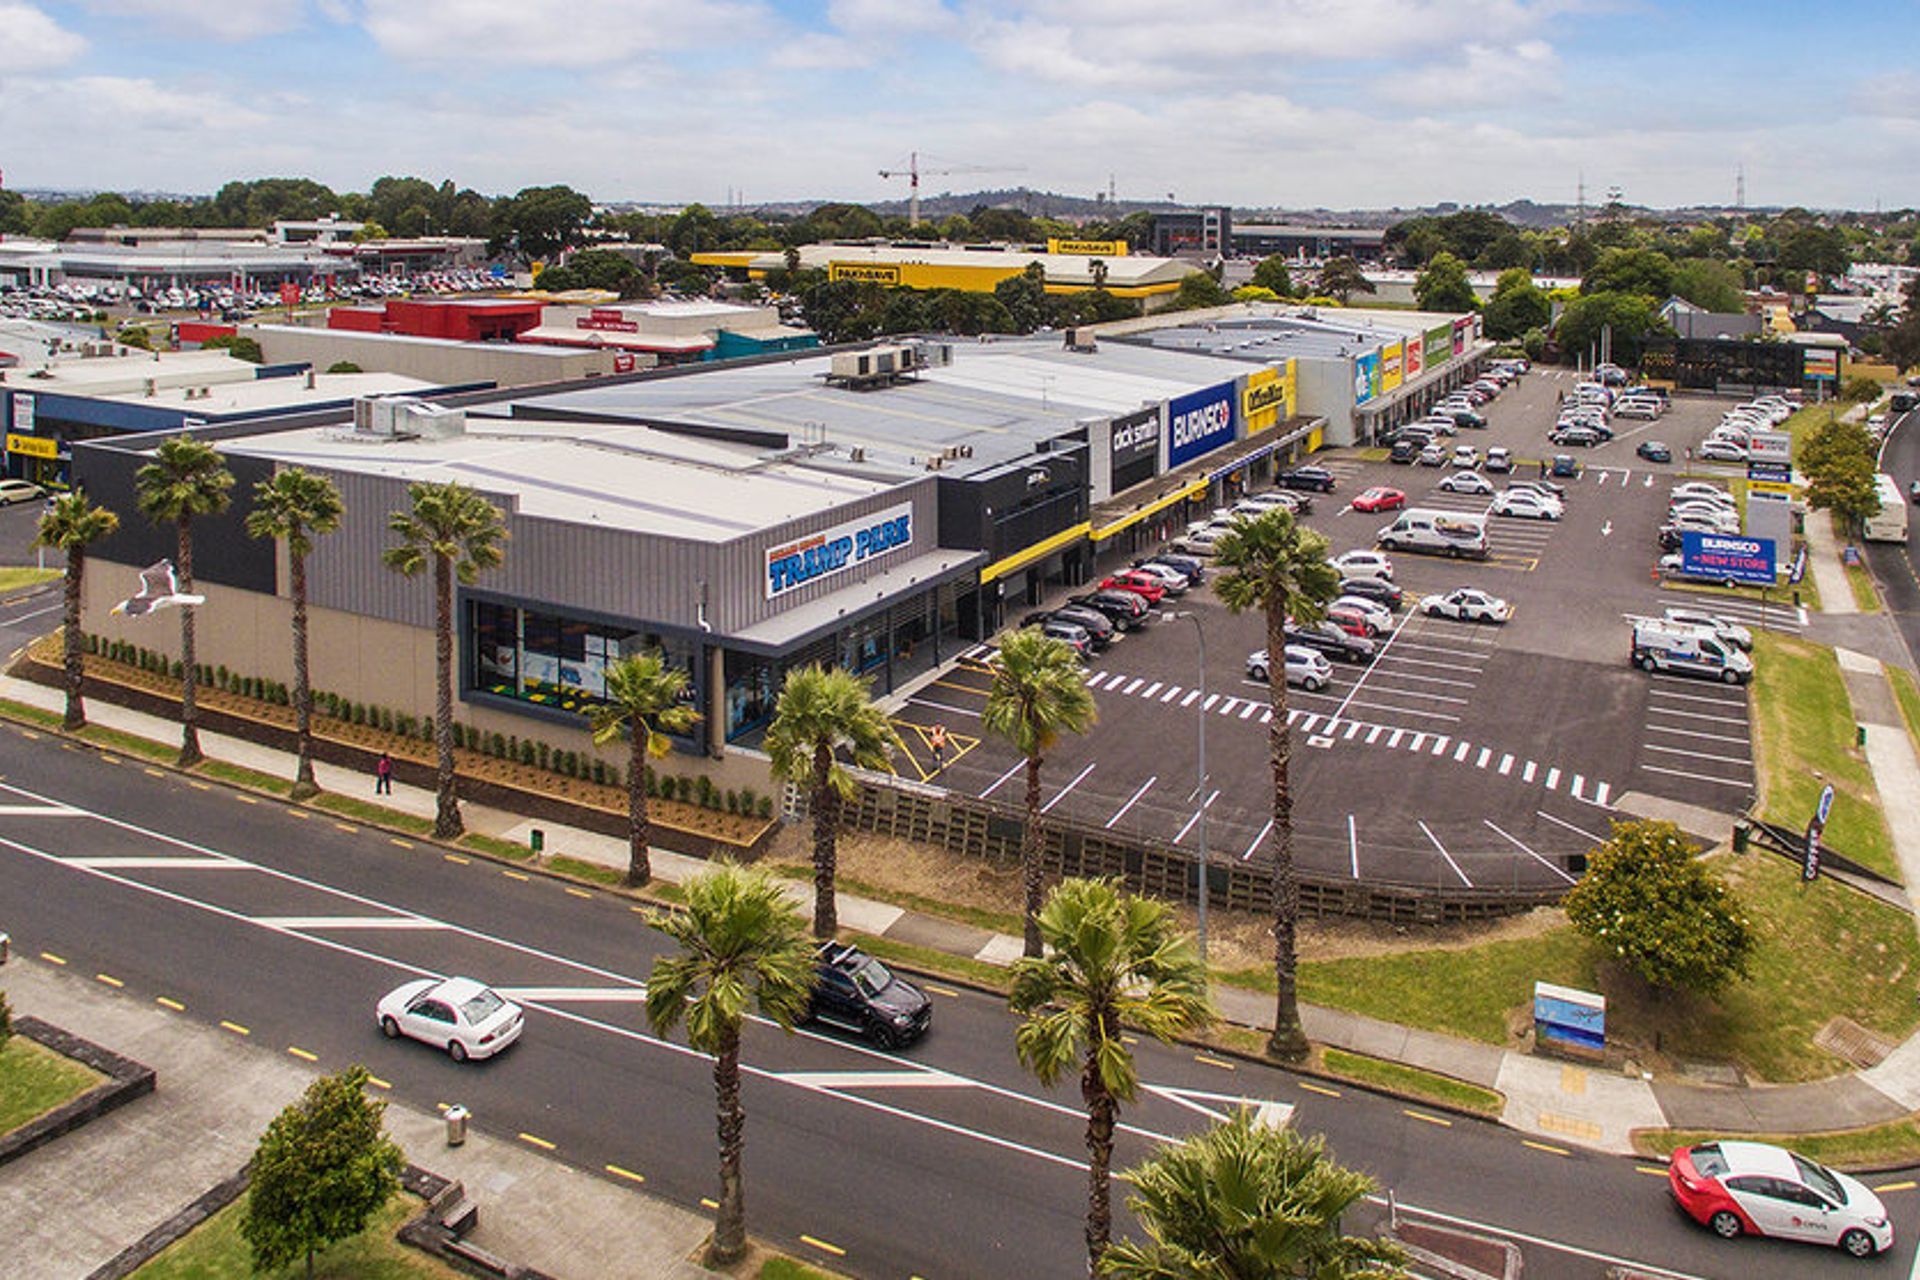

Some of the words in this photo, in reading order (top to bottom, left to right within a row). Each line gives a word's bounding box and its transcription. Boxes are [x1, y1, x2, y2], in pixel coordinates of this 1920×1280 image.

[1173, 399, 1230, 449] BURNSCO
[769, 536, 853, 593] TRAMP
[855, 514, 911, 560] PARK
[1701, 554, 1729, 566] NEW
[1730, 557, 1768, 570] STORE
[1702, 538, 1761, 553] BURNSCO
